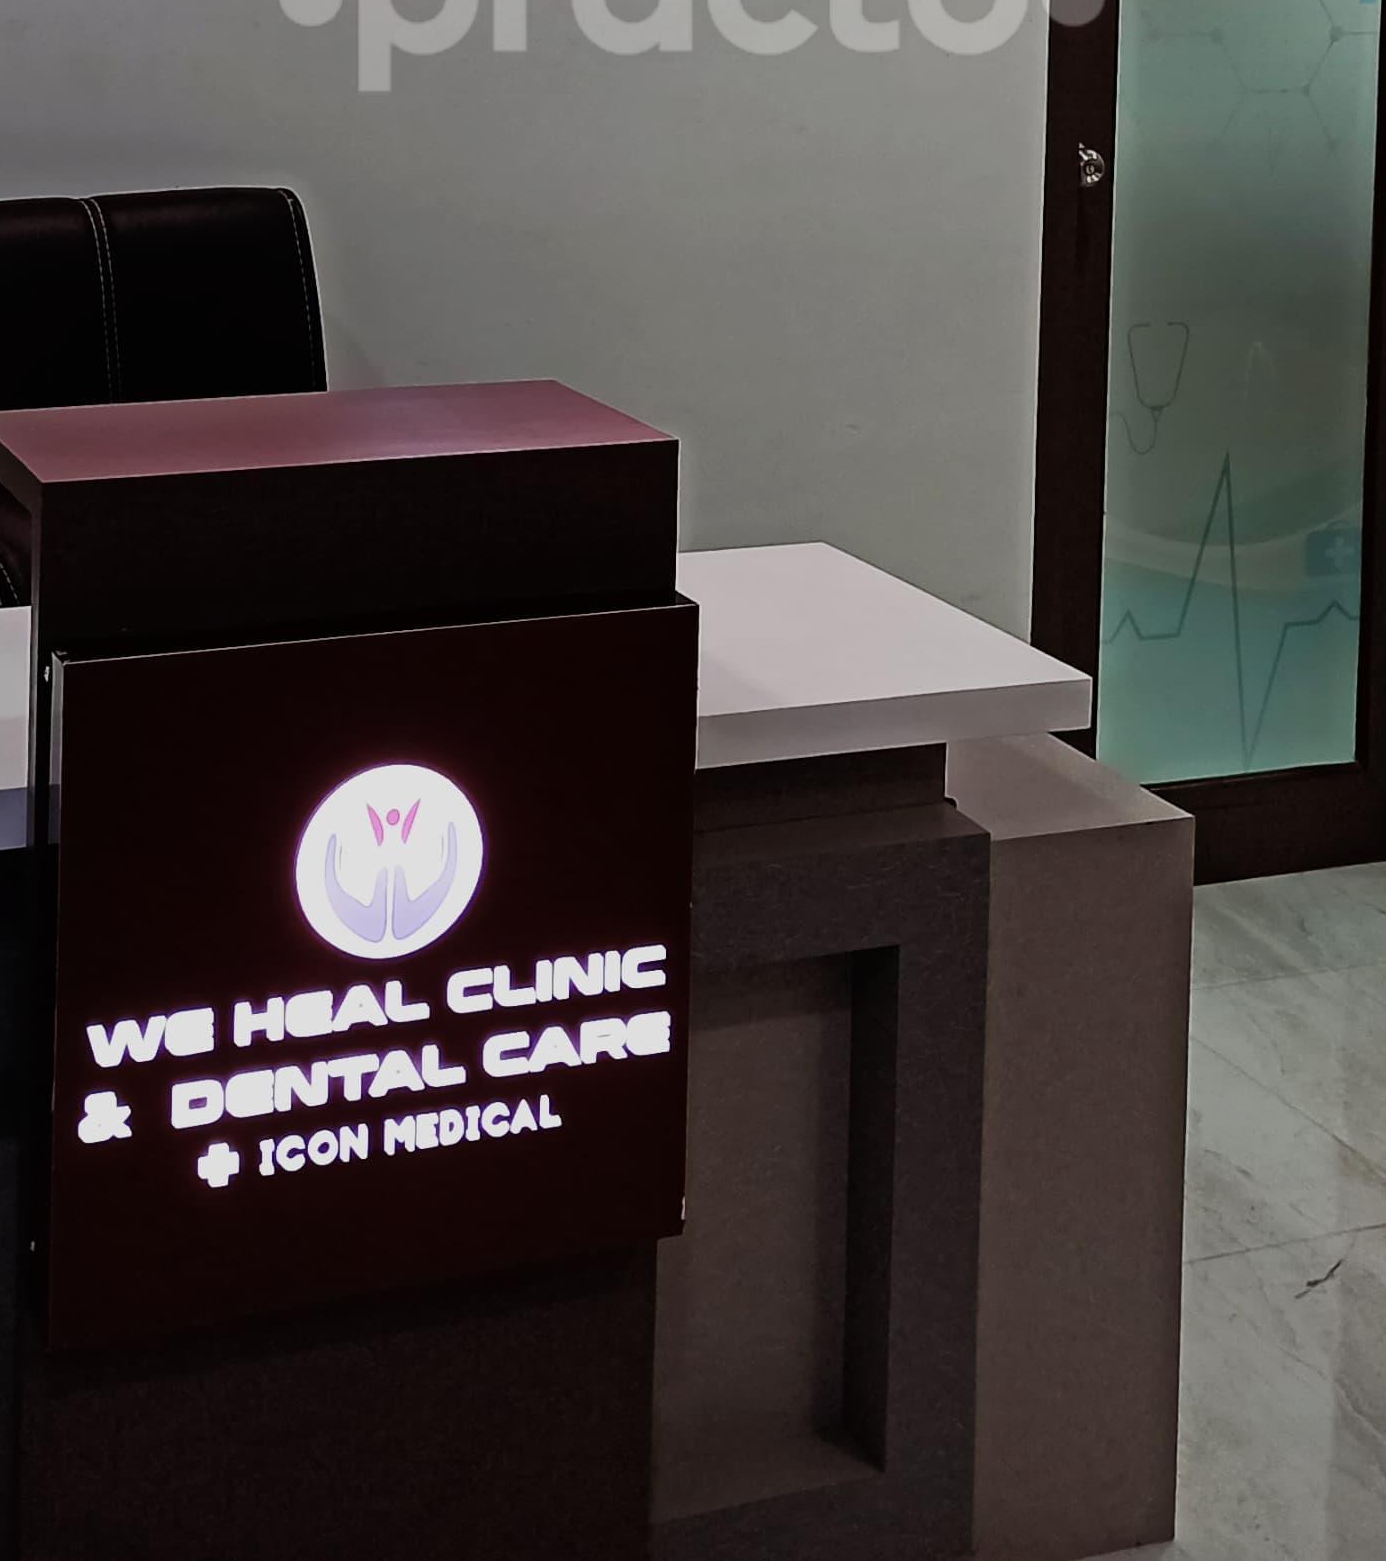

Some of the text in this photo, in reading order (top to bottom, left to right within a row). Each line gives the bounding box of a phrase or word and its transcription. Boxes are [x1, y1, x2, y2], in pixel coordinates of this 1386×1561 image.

[86, 944, 667, 1068] WE HEAL CLINIC
[77, 1010, 671, 1144] & DENTAL CARE
[259, 1094, 563, 1177] ICON MEDICAL
